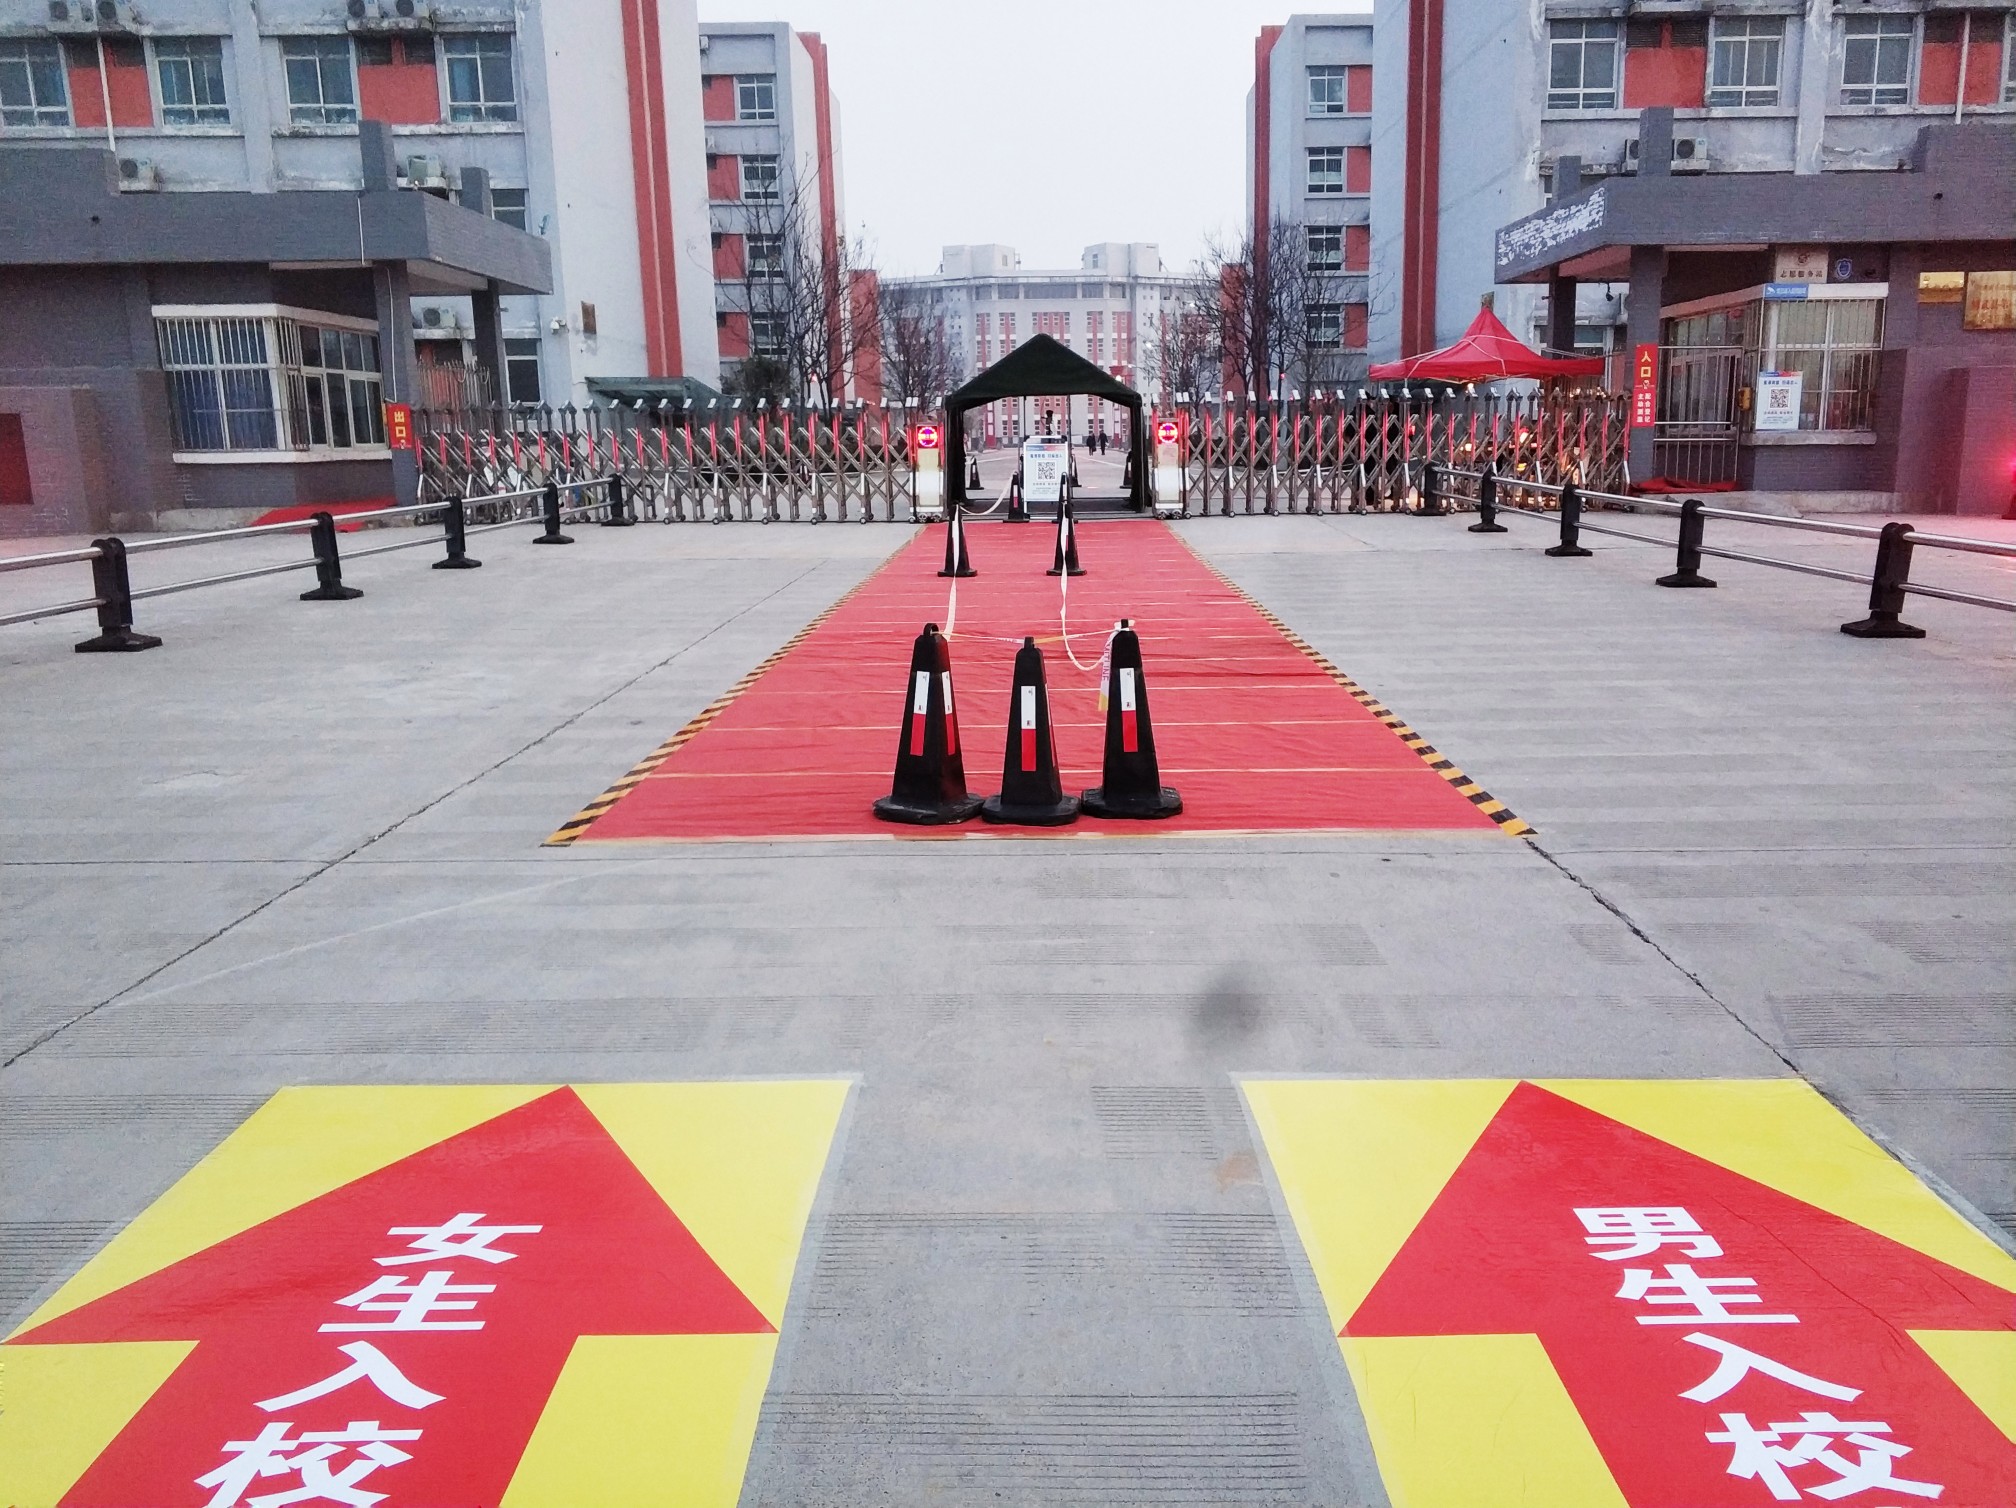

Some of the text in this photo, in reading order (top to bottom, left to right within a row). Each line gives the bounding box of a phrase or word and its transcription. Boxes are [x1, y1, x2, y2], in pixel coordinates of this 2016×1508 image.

[394, 412, 406, 437] 出口
[194, 1213, 543, 1508] 女生入校
[1573, 1207, 1944, 1500] 男生入校
